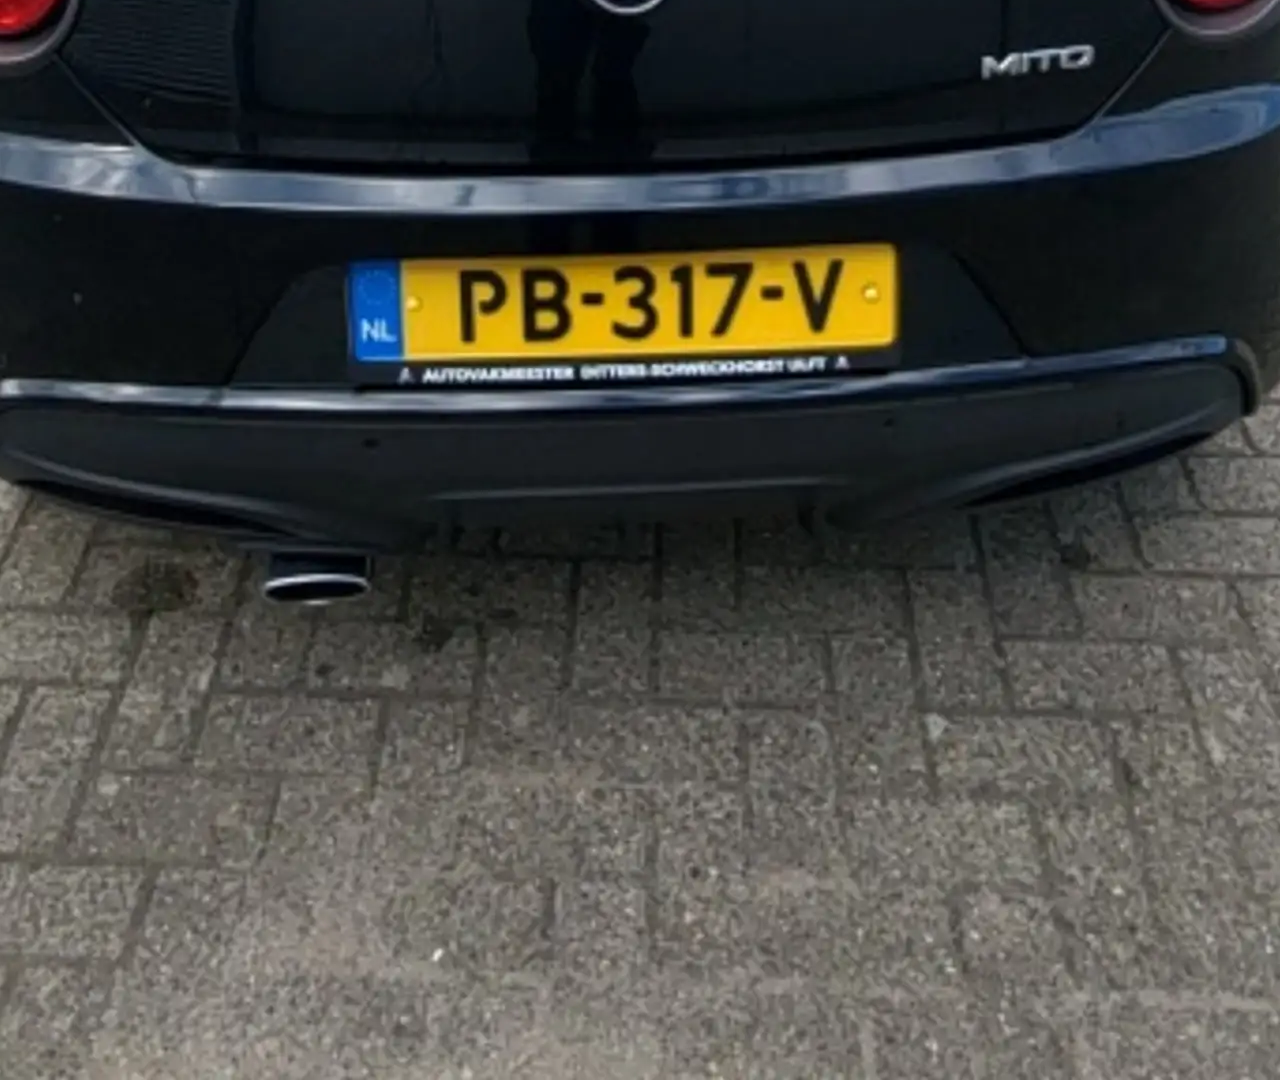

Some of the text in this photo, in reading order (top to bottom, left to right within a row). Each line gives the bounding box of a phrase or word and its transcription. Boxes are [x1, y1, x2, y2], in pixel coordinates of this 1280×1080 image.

[981, 45, 1095, 80] MITO
[459, 260, 844, 343] PB-317-V
[361, 319, 397, 342] NL
[422, 366, 575, 384] AUTOVAKMEESTER
